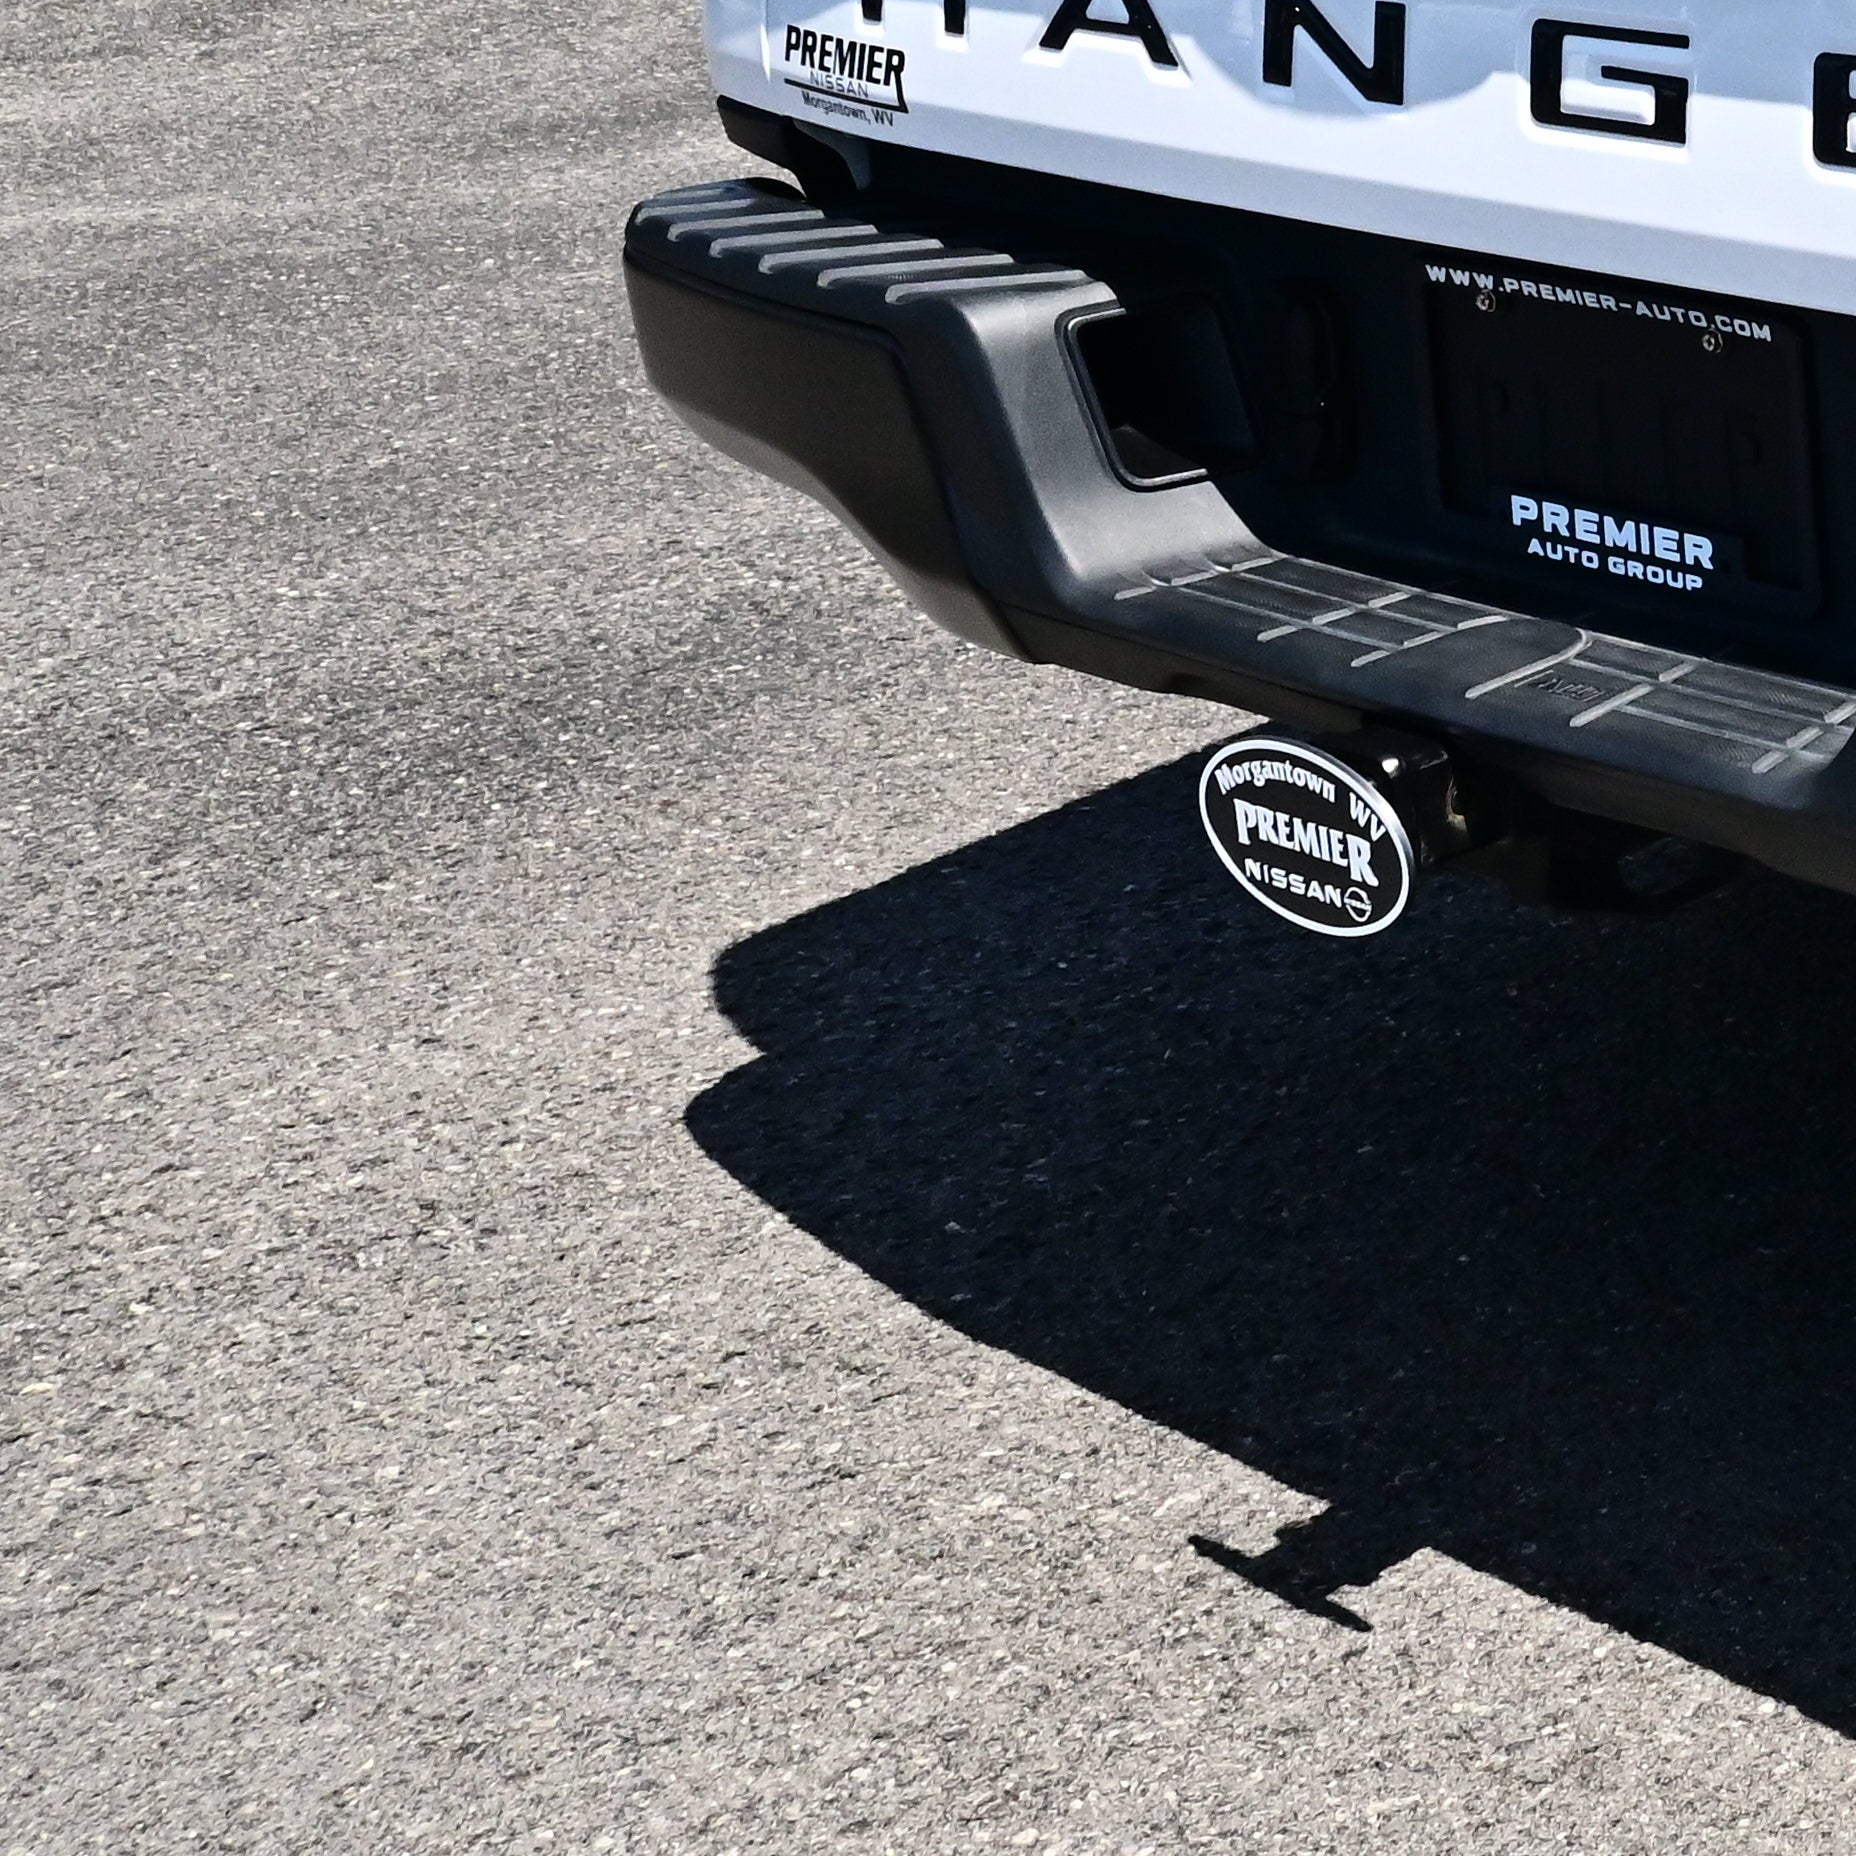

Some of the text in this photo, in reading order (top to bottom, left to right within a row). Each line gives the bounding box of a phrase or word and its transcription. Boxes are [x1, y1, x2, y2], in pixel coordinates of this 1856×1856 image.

[785, 24, 908, 101] PREMIER
[810, 70, 868, 98] NISSAN
[871, 107, 894, 126] WV
[1425, 264, 1772, 342] WWW.PREMIER-AUTO.COM
[1511, 495, 1714, 570] PREMIER
[1527, 538, 1703, 591] AUTO GROUP
[1214, 760, 1386, 842] Morgantown WV
[1233, 798, 1379, 887] PREMIER
[1244, 858, 1342, 908] NISSAN
